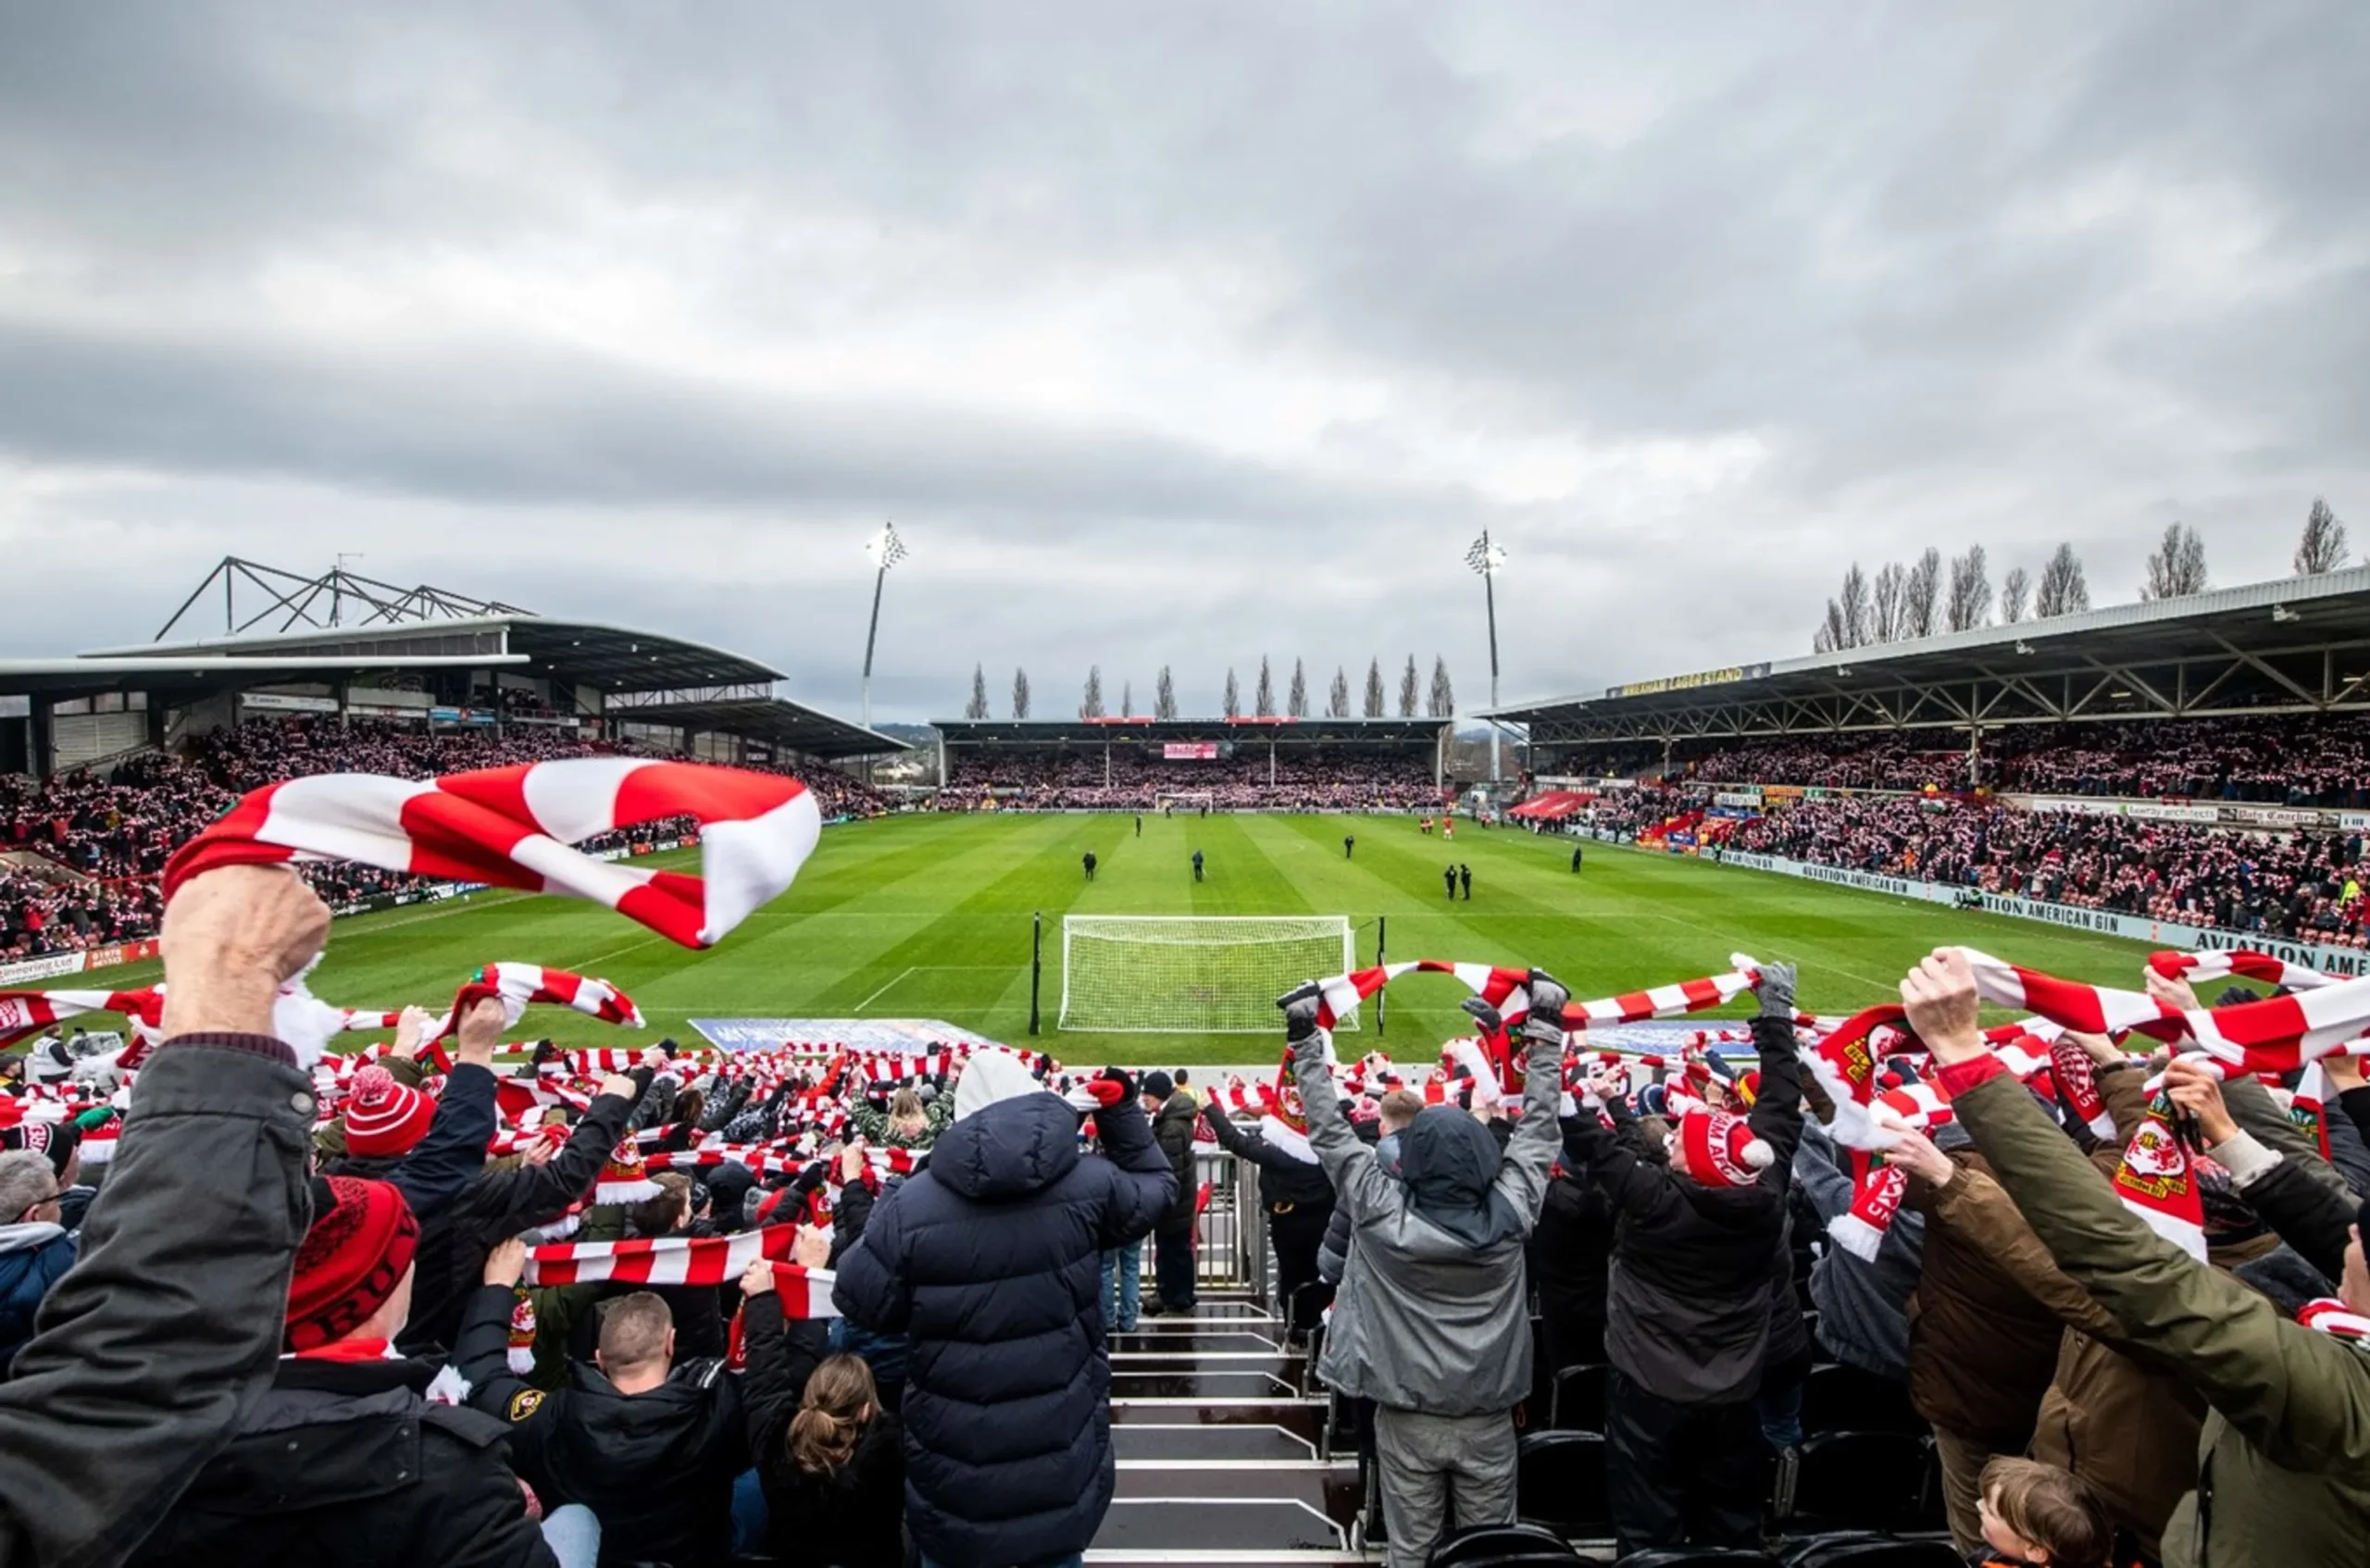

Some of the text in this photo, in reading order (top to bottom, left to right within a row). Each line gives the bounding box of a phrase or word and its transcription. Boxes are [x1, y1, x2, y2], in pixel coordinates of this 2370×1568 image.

[1669, 674, 1702, 691] LAGER
[1704, 667, 1743, 685] STAND
[1802, 865, 1851, 883] AVIATION
[2027, 902, 2090, 927] AMERICAN
[2094, 916, 2118, 932] GIN
